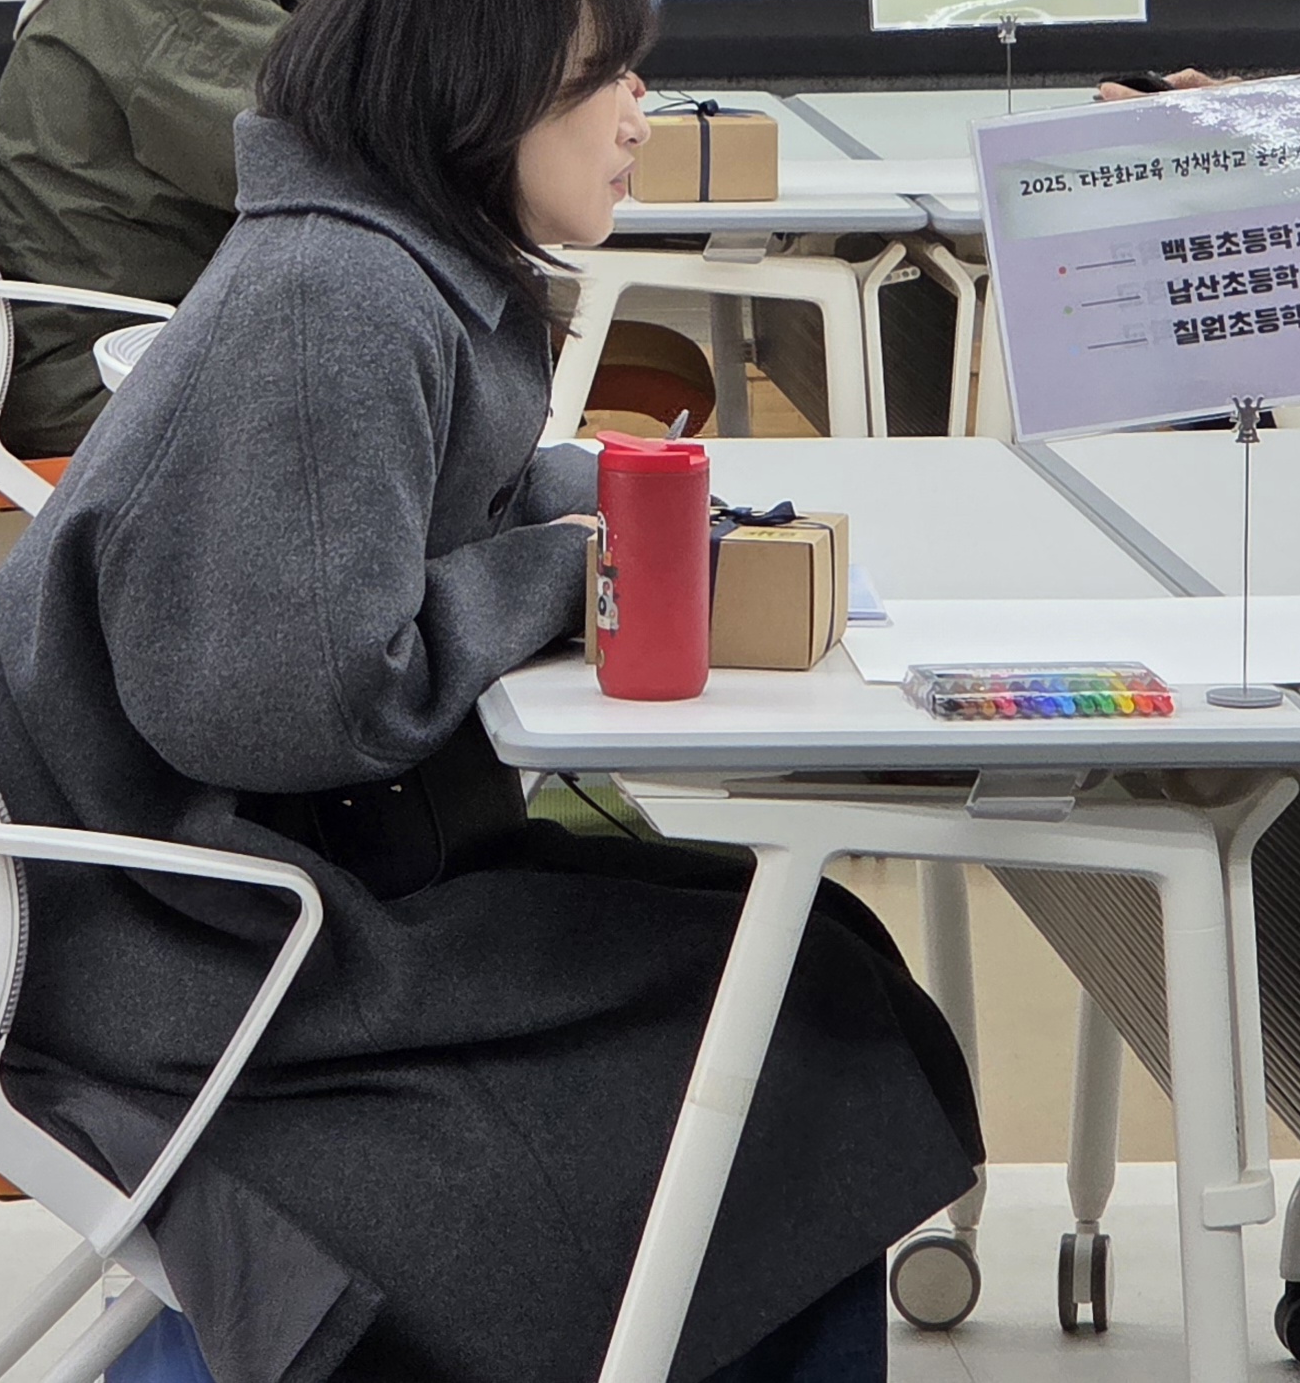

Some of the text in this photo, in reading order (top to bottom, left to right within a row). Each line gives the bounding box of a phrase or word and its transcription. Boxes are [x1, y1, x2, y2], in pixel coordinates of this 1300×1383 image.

[1020, 174, 1073, 197] 2025.
[1079, 158, 1164, 189] 다문화교육
[1172, 149, 1248, 178] 정책학교
